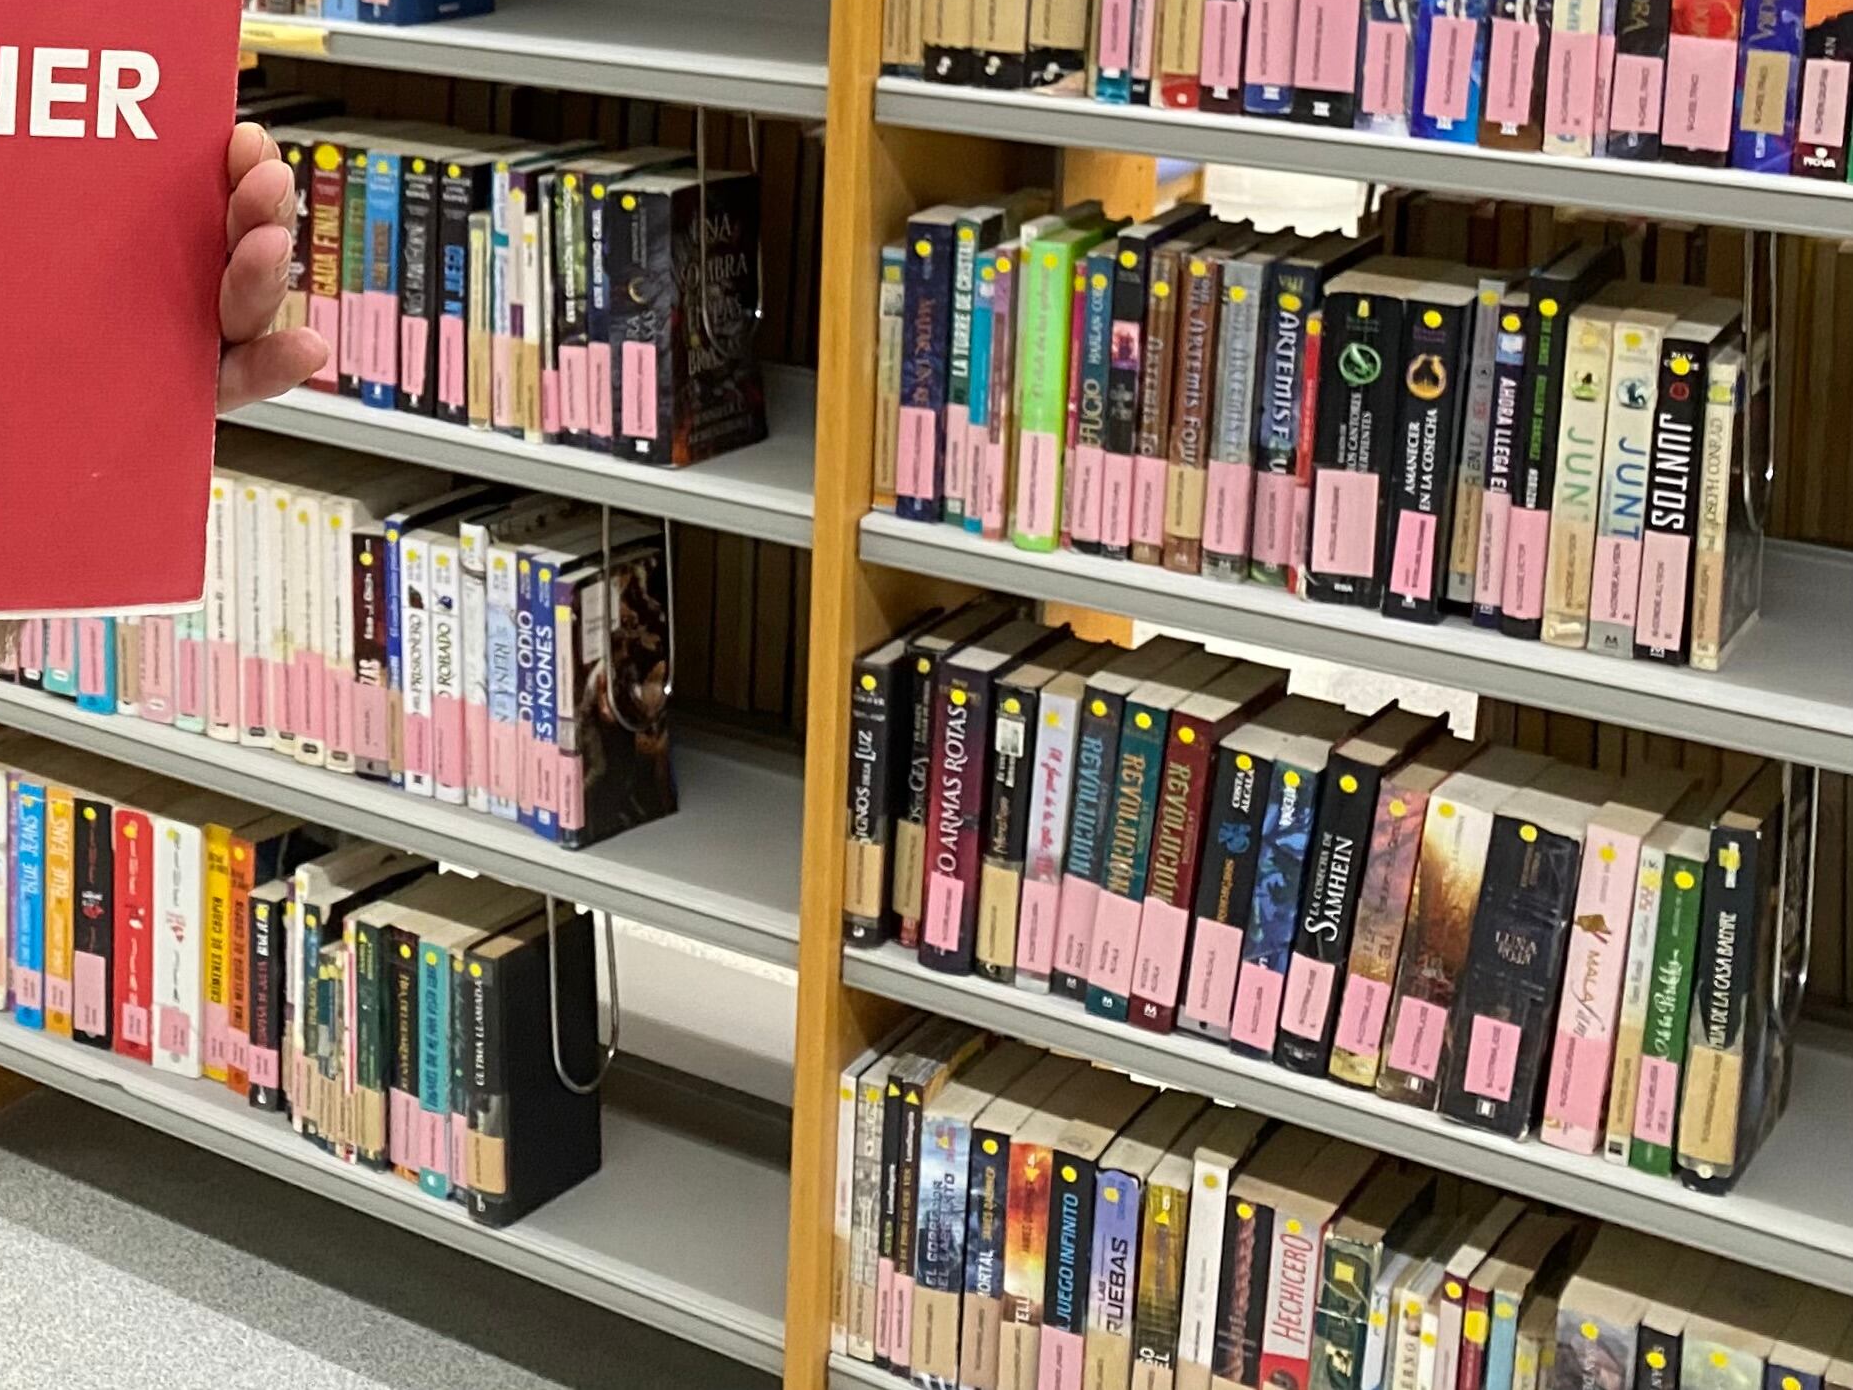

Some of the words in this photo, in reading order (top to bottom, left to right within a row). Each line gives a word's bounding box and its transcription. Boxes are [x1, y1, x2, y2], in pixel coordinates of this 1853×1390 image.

[1184, 316, 1208, 408] ARTEMIS
[1271, 310, 1301, 424] ARTEMIS
[1078, 378, 1104, 449] EFUGIO
[1497, 376, 1518, 425] AHORA
[1404, 420, 1421, 496] AMANECER
[1421, 408, 1438, 472] COSECHA
[1493, 428, 1514, 476] LLEGA
[1650, 412, 1693, 532] JUNTOS
[1420, 473, 1433, 491] LA
[435, 622, 453, 687] ROBADO
[517, 609, 534, 669] ODIO
[535, 625, 553, 707] NONES
[854, 729, 876, 761] LUZ
[943, 704, 968, 771] ROTAS
[21, 815, 40, 857] JEANS
[940, 775, 964, 854] ARMAS
[20, 862, 40, 896] BLUE
[1304, 835, 1354, 942] SAMHEIN
[1059, 1192, 1078, 1265] INFINITO
[1056, 1266, 1075, 1321] JUEGO
[1106, 1236, 1129, 1337] RUEBAS
[1271, 1232, 1315, 1346] HECHICERO
